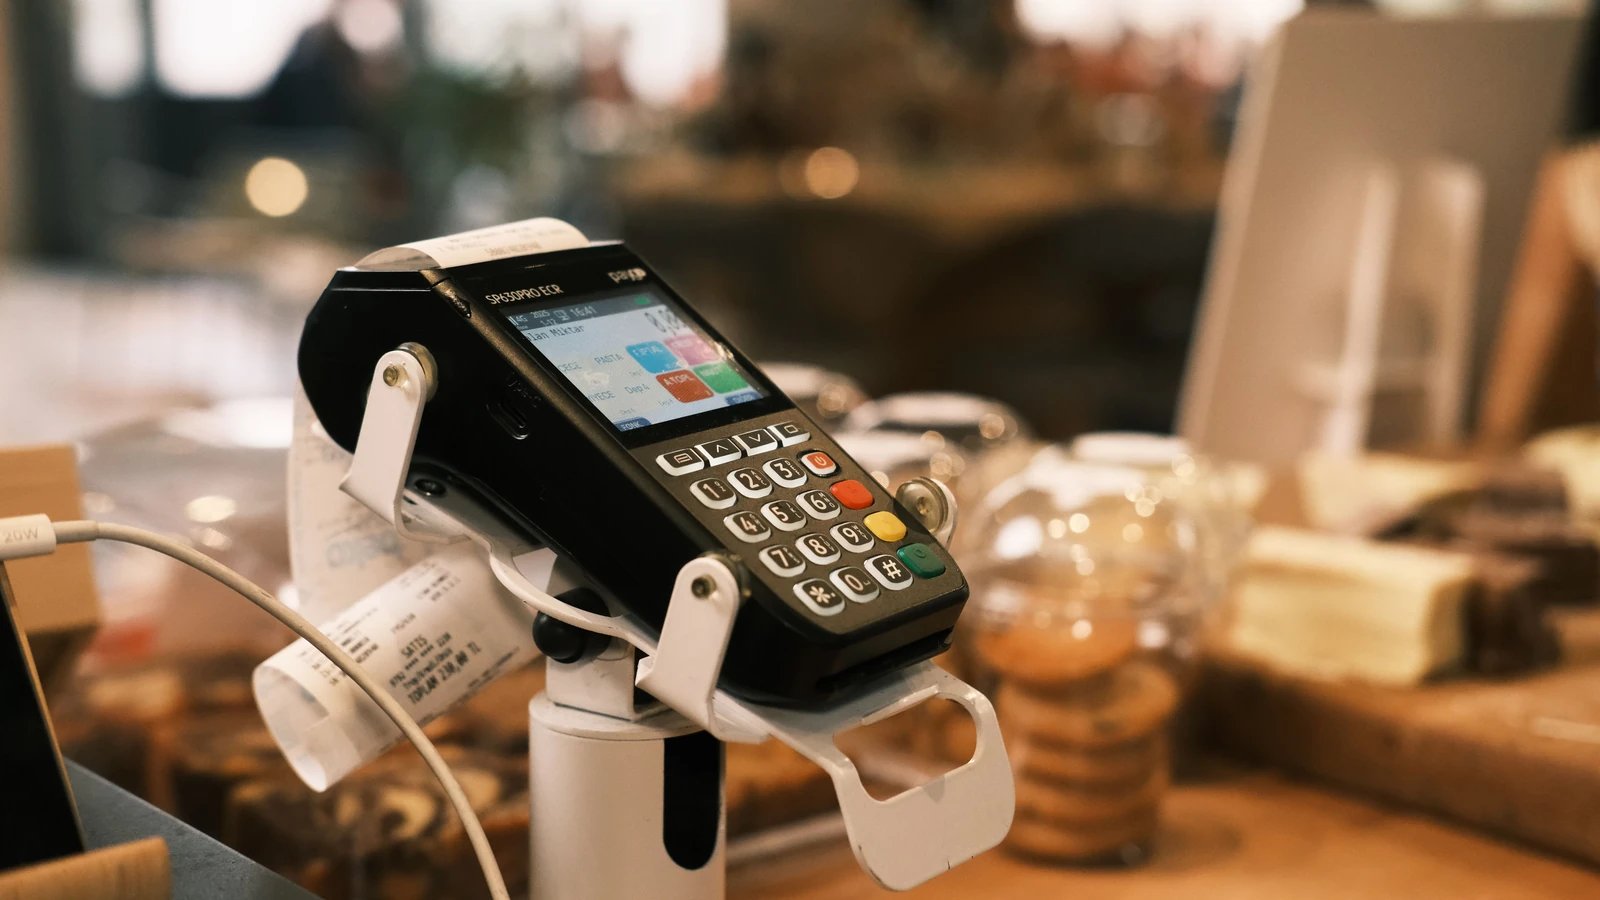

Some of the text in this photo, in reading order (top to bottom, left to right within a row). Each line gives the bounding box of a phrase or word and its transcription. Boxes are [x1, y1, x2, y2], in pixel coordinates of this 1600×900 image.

[485, 284, 564, 305] SP630PRO ECR
[570, 305, 598, 317] 16:41
[549, 325, 585, 337] Miktar
[594, 354, 624, 365] PASTA
[624, 386, 642, 396] Dep
[773, 462, 793, 478] 3
[739, 473, 760, 489] 2
[702, 483, 720, 499] 1
[810, 494, 827, 510] 6
[771, 506, 789, 522] 5
[740, 516, 758, 532] 4
[842, 527, 859, 543] 9
[808, 539, 828, 555] 8
[770, 549, 789, 567] 7
[844, 574, 864, 591] 0
